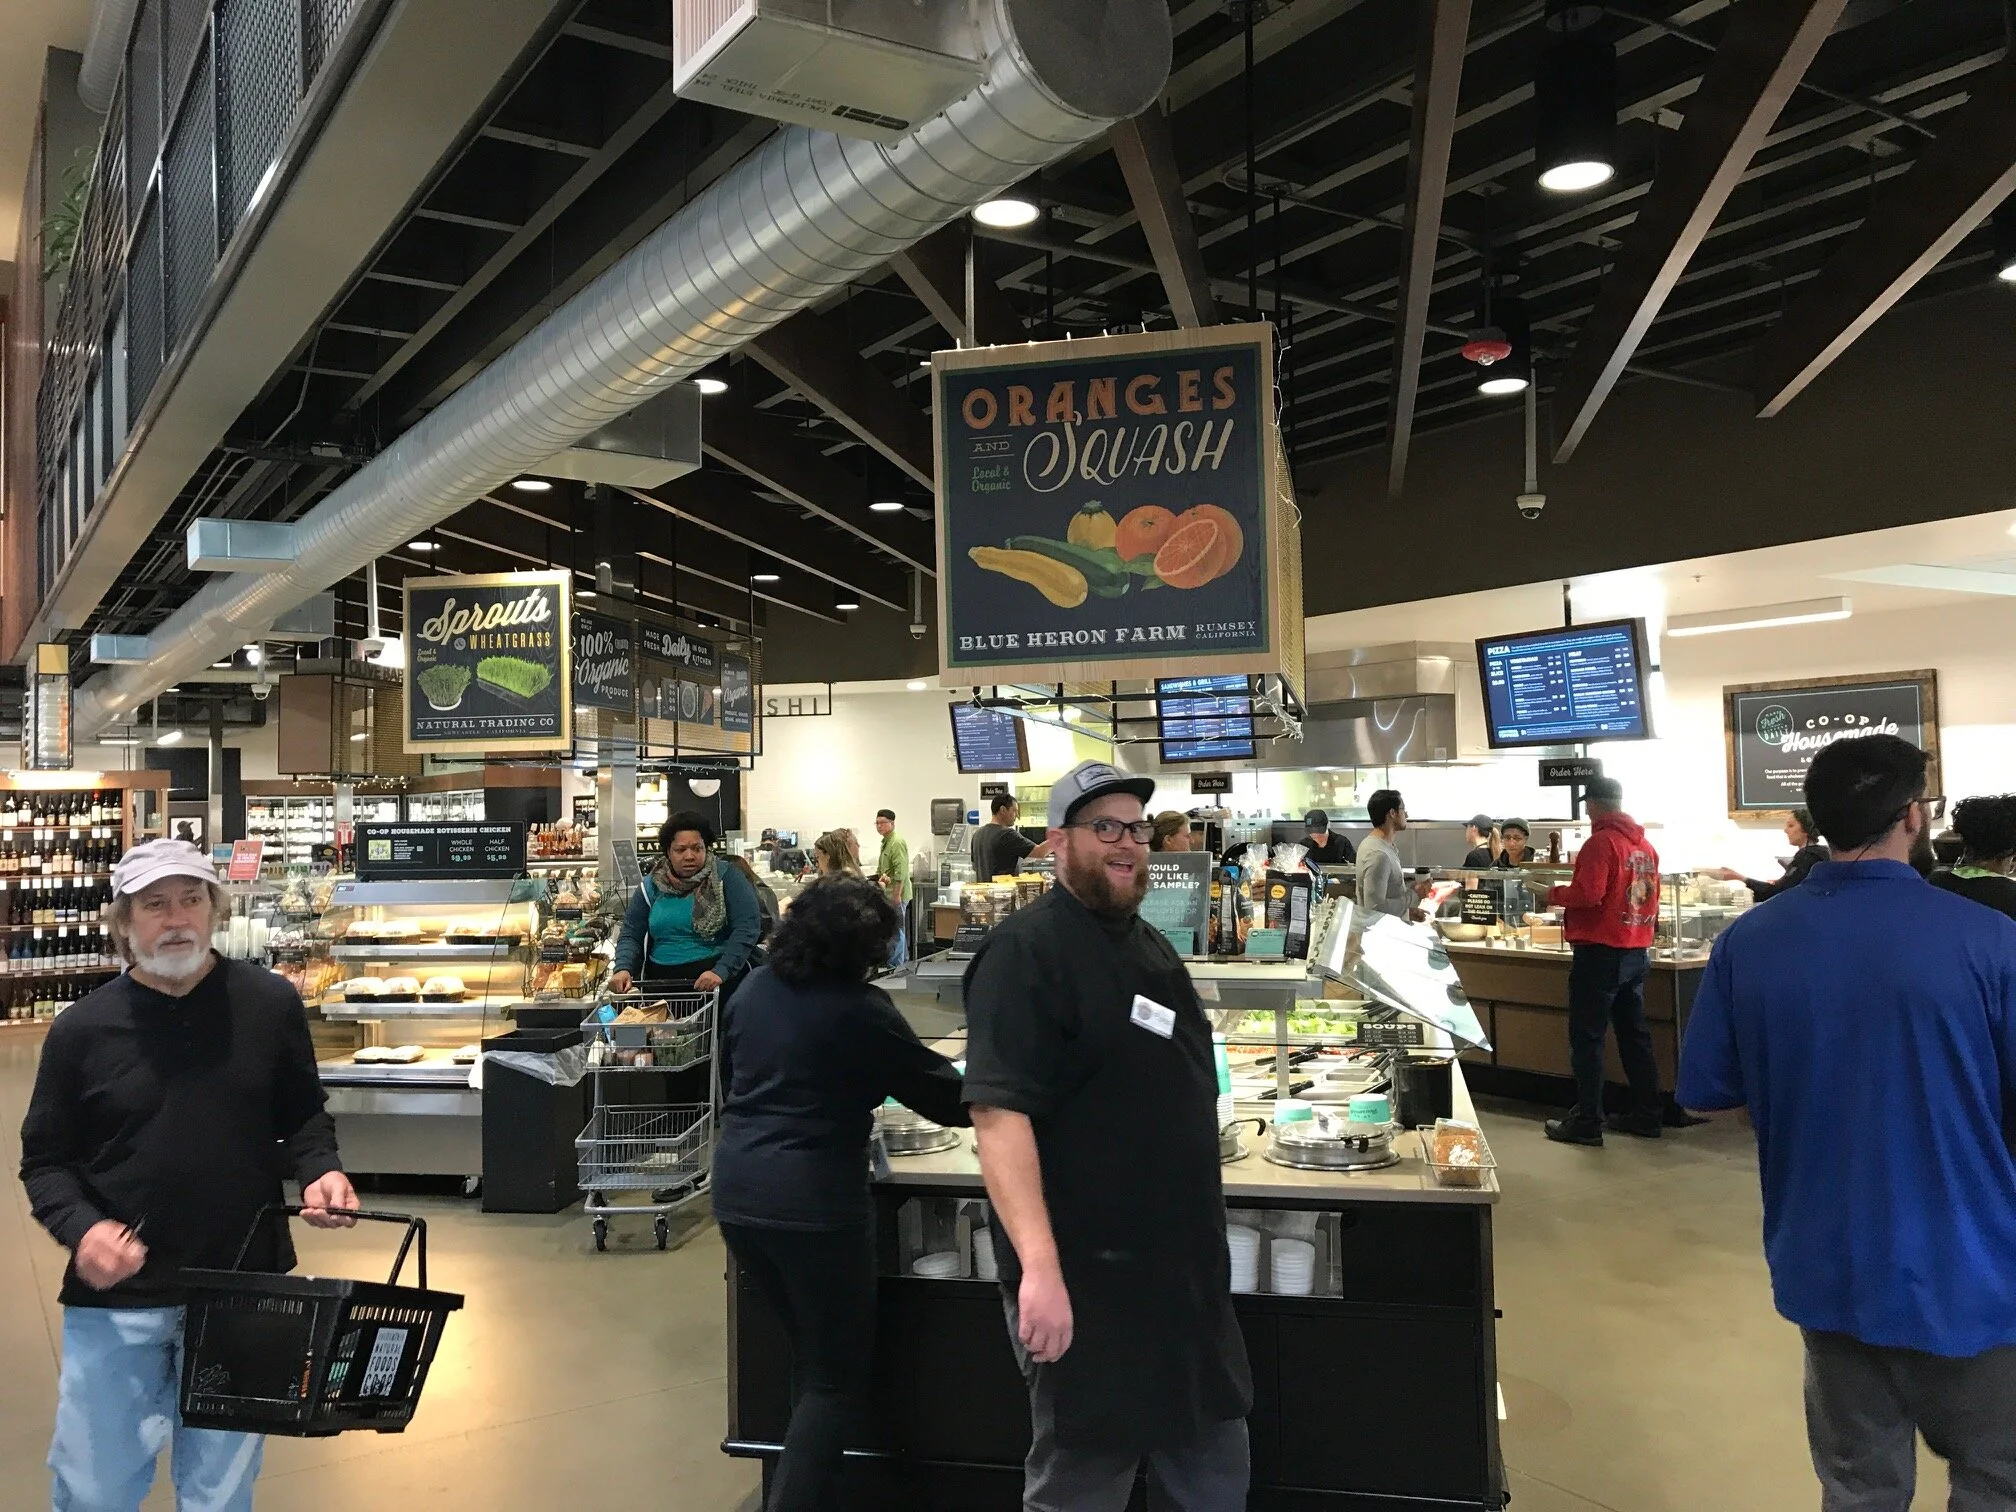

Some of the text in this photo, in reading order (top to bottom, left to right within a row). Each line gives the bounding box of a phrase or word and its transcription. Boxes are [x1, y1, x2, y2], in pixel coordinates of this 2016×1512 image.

[962, 366, 1236, 430] ORANGES
[972, 441, 1010, 452] AND
[972, 464, 1000, 480] Local
[972, 478, 1011, 494] Organic
[416, 588, 552, 646] Sprouts
[1196, 620, 1256, 632] RUMSEY
[470, 632, 551, 650] WHEATGRASS
[645, 630, 660, 640] MADE
[959, 624, 1186, 650] BLUE HERON FARM
[1196, 630, 1256, 640] CALIFORNIA
[580, 630, 614, 658] 100%
[643, 640, 660, 651] FRESH
[662, 634, 692, 665] Daily
[698, 645, 708, 654] OUR
[1487, 645, 1510, 656] PIZZA
[692, 654, 712, 666] KITCHEN
[578, 651, 629, 694] Organic
[601, 684, 629, 700] PRODUCE
[723, 682, 748, 708] Organic
[416, 718, 554, 730] NATURAL TRADING CO
[1806, 714, 1870, 729] CO-OP
[1550, 766, 1594, 777] Order Here
[370, 1356, 398, 1372] FOODS
